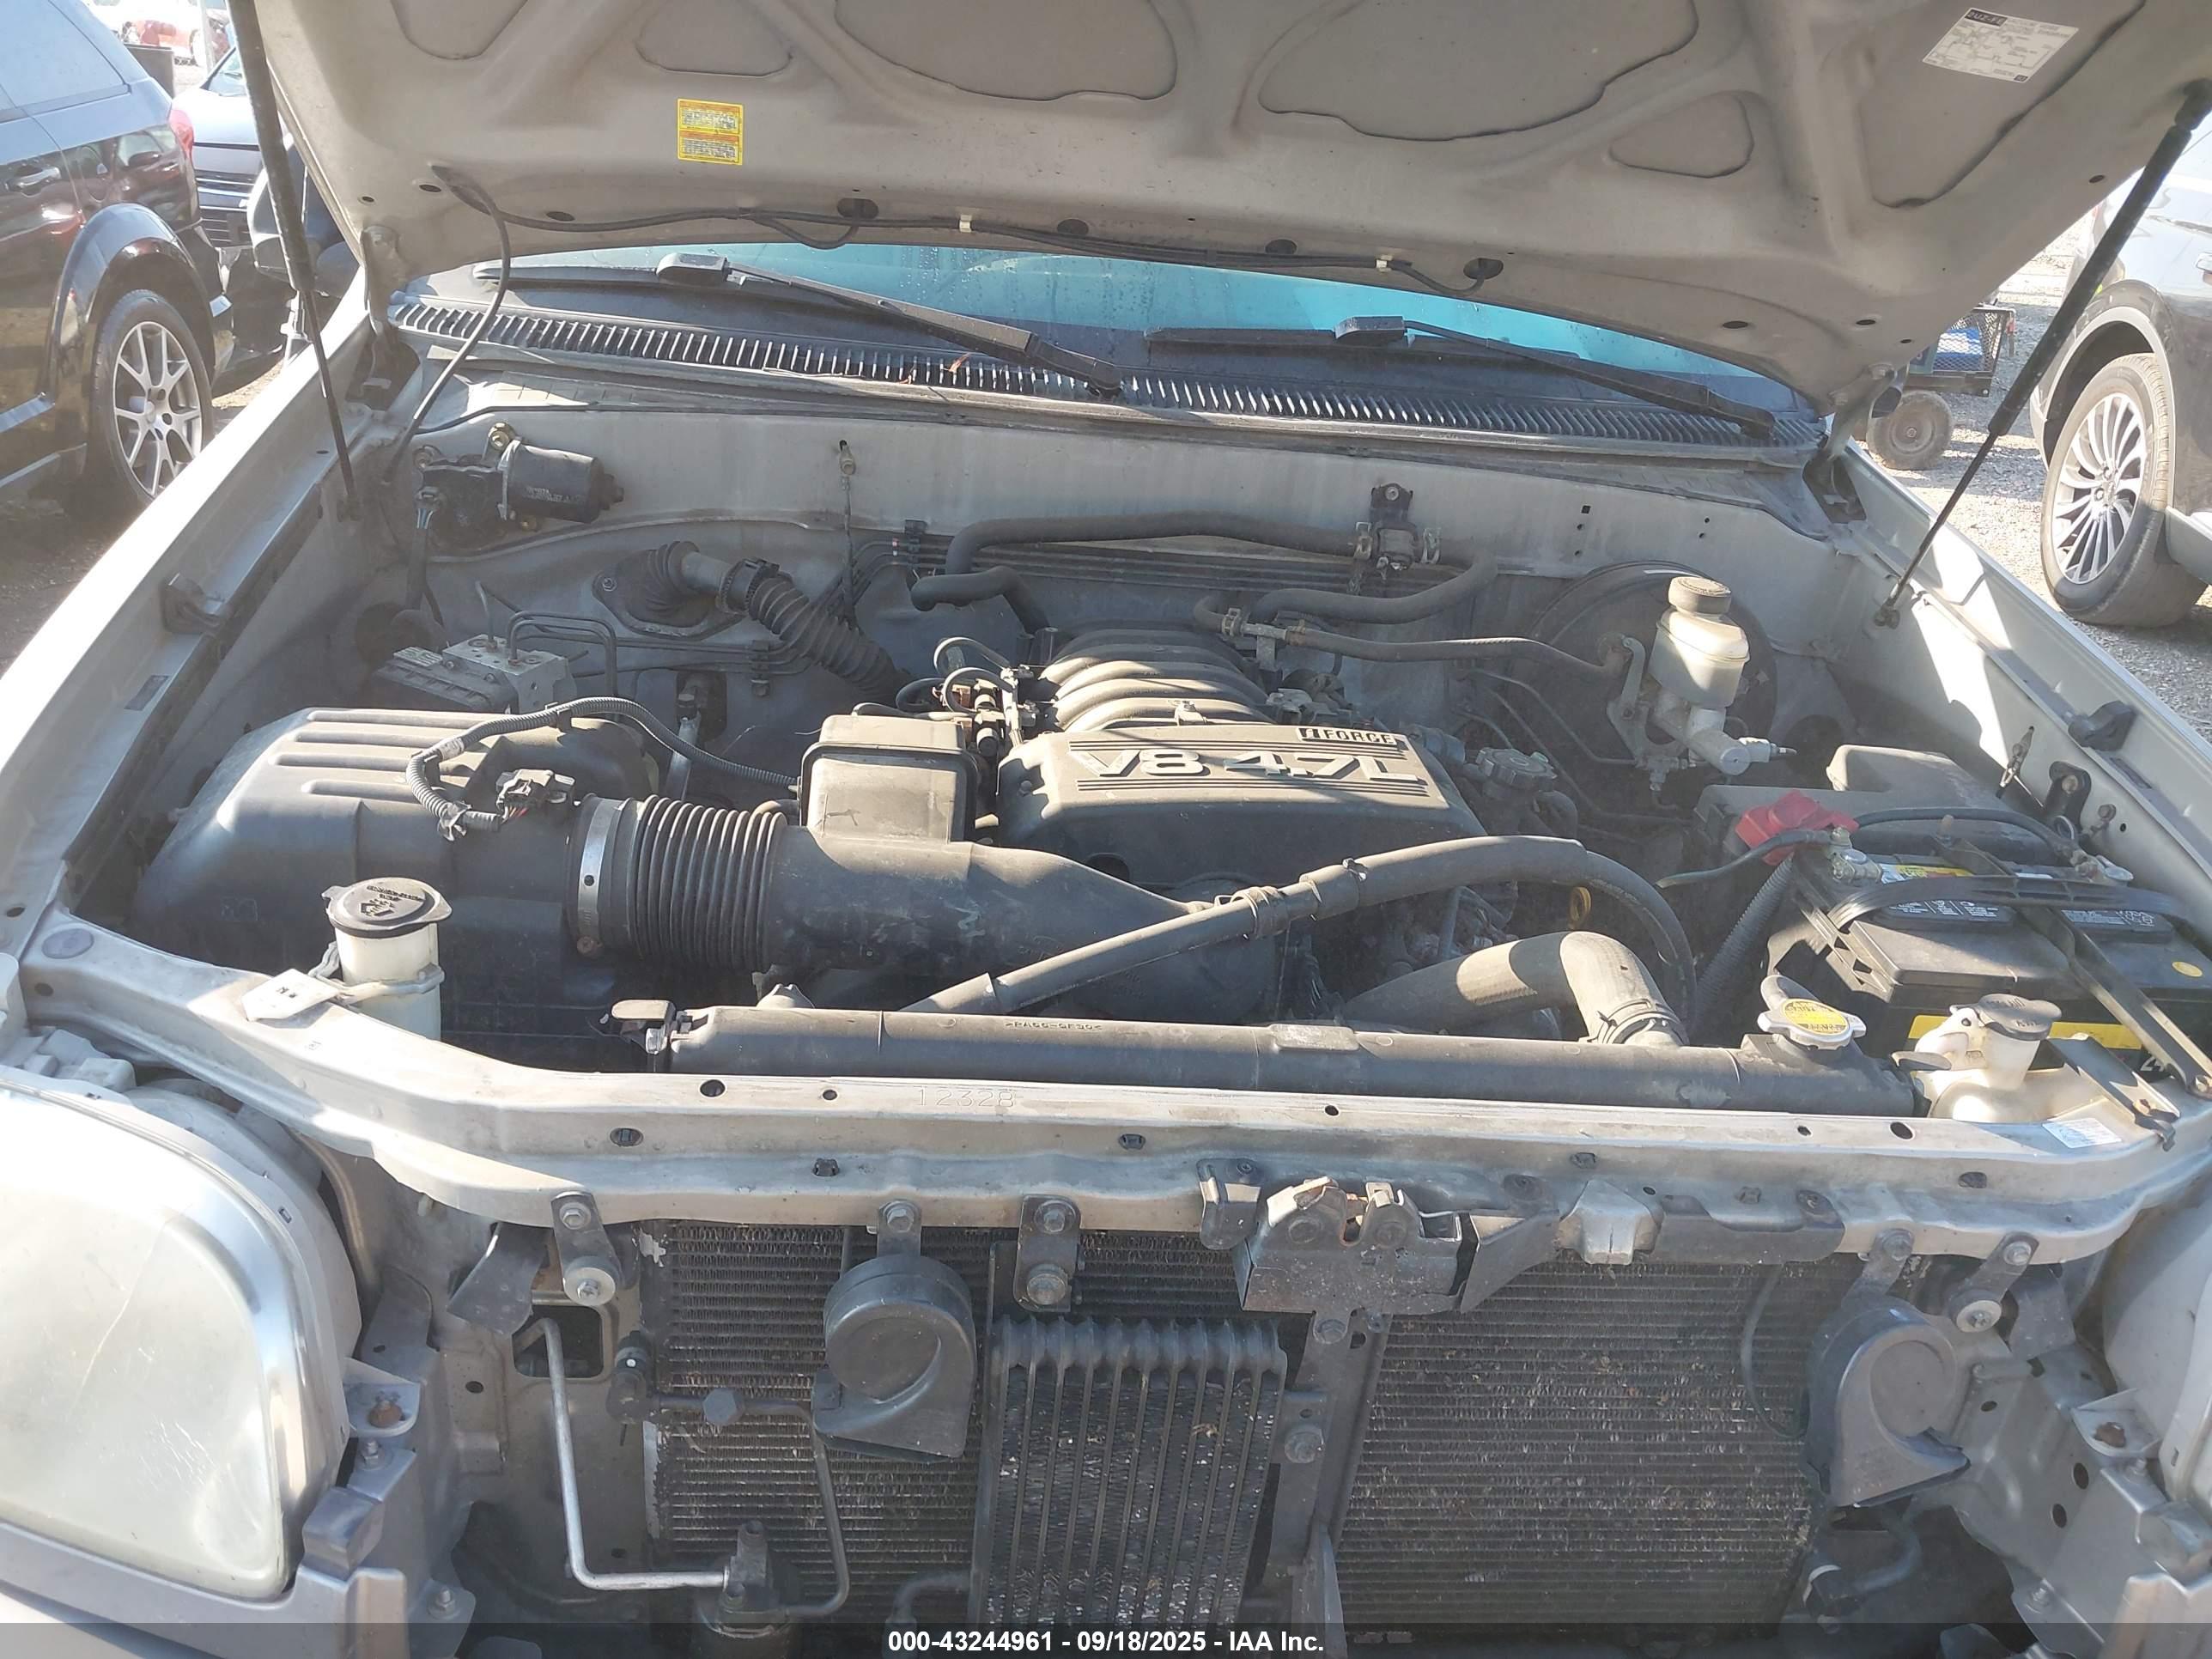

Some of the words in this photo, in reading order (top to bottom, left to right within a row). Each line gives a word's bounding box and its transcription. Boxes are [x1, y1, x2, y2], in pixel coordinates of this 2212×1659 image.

[1069, 750, 1204, 777] V8
[1223, 750, 1419, 781] 4.7L
[919, 1088, 1015, 1108] 12328
